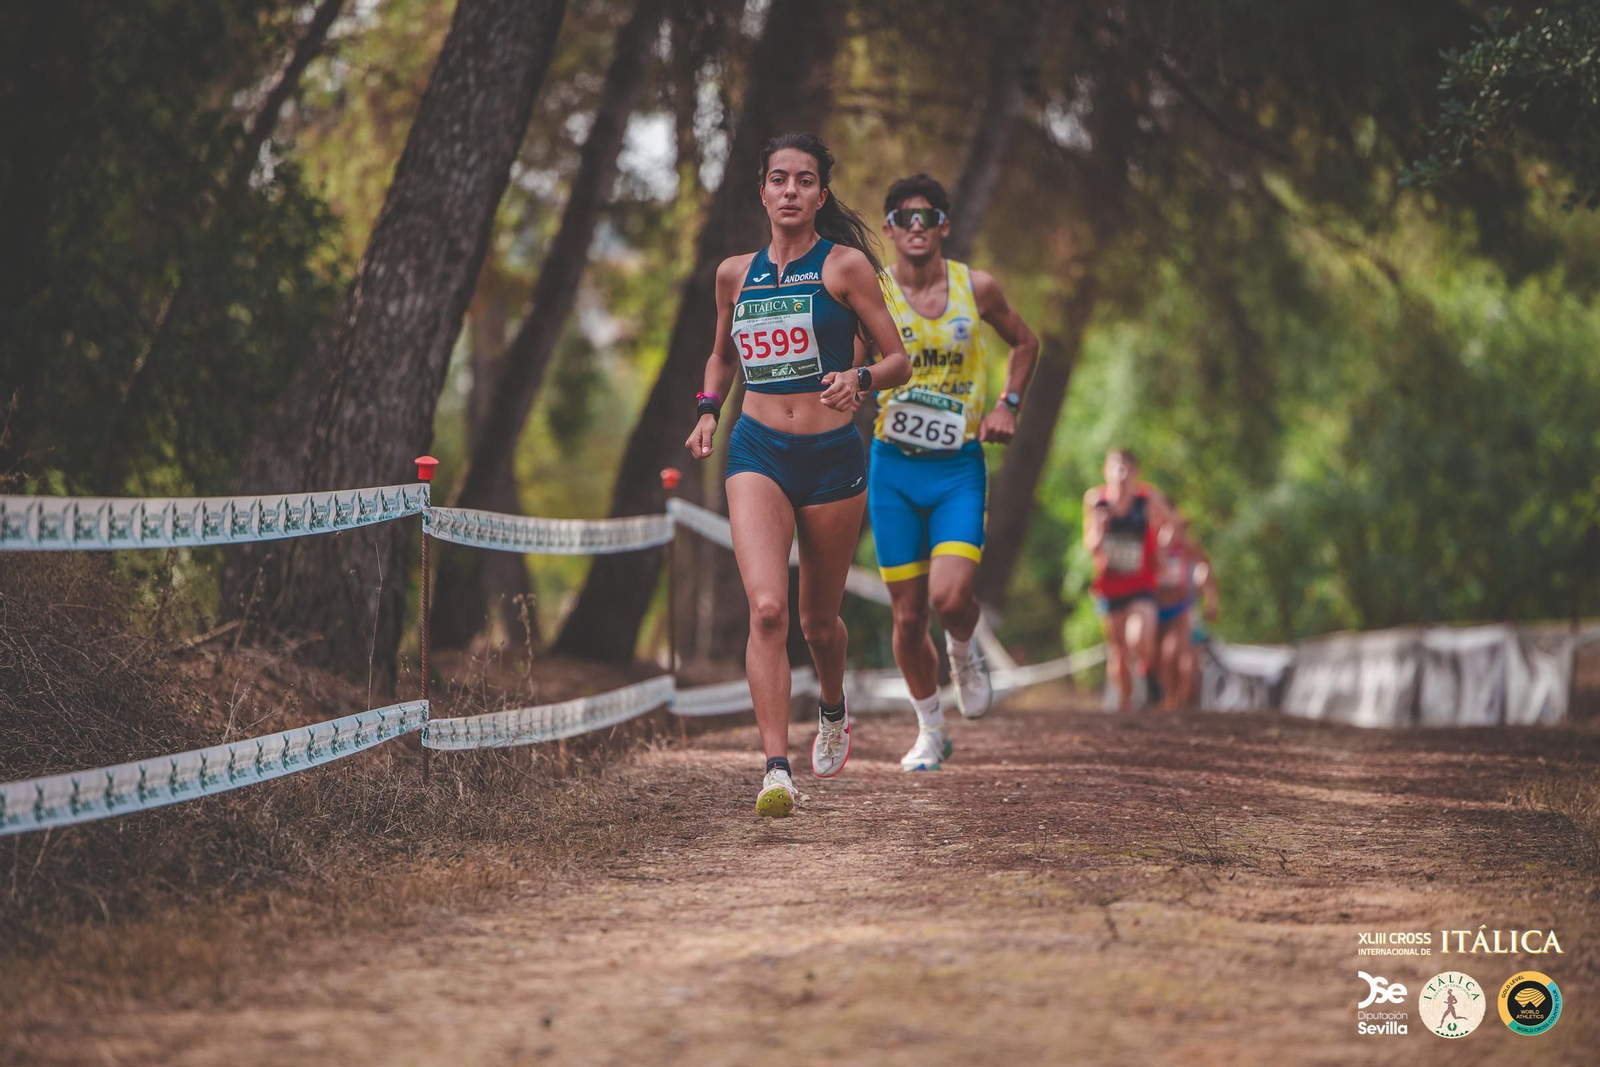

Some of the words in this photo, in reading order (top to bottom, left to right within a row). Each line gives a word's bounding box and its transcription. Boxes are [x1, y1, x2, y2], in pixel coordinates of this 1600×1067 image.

[784, 272, 818, 283] ANDORRA
[748, 300, 788, 314] ITÁLICA
[739, 326, 809, 360] 5599
[892, 412, 958, 446] 8265
